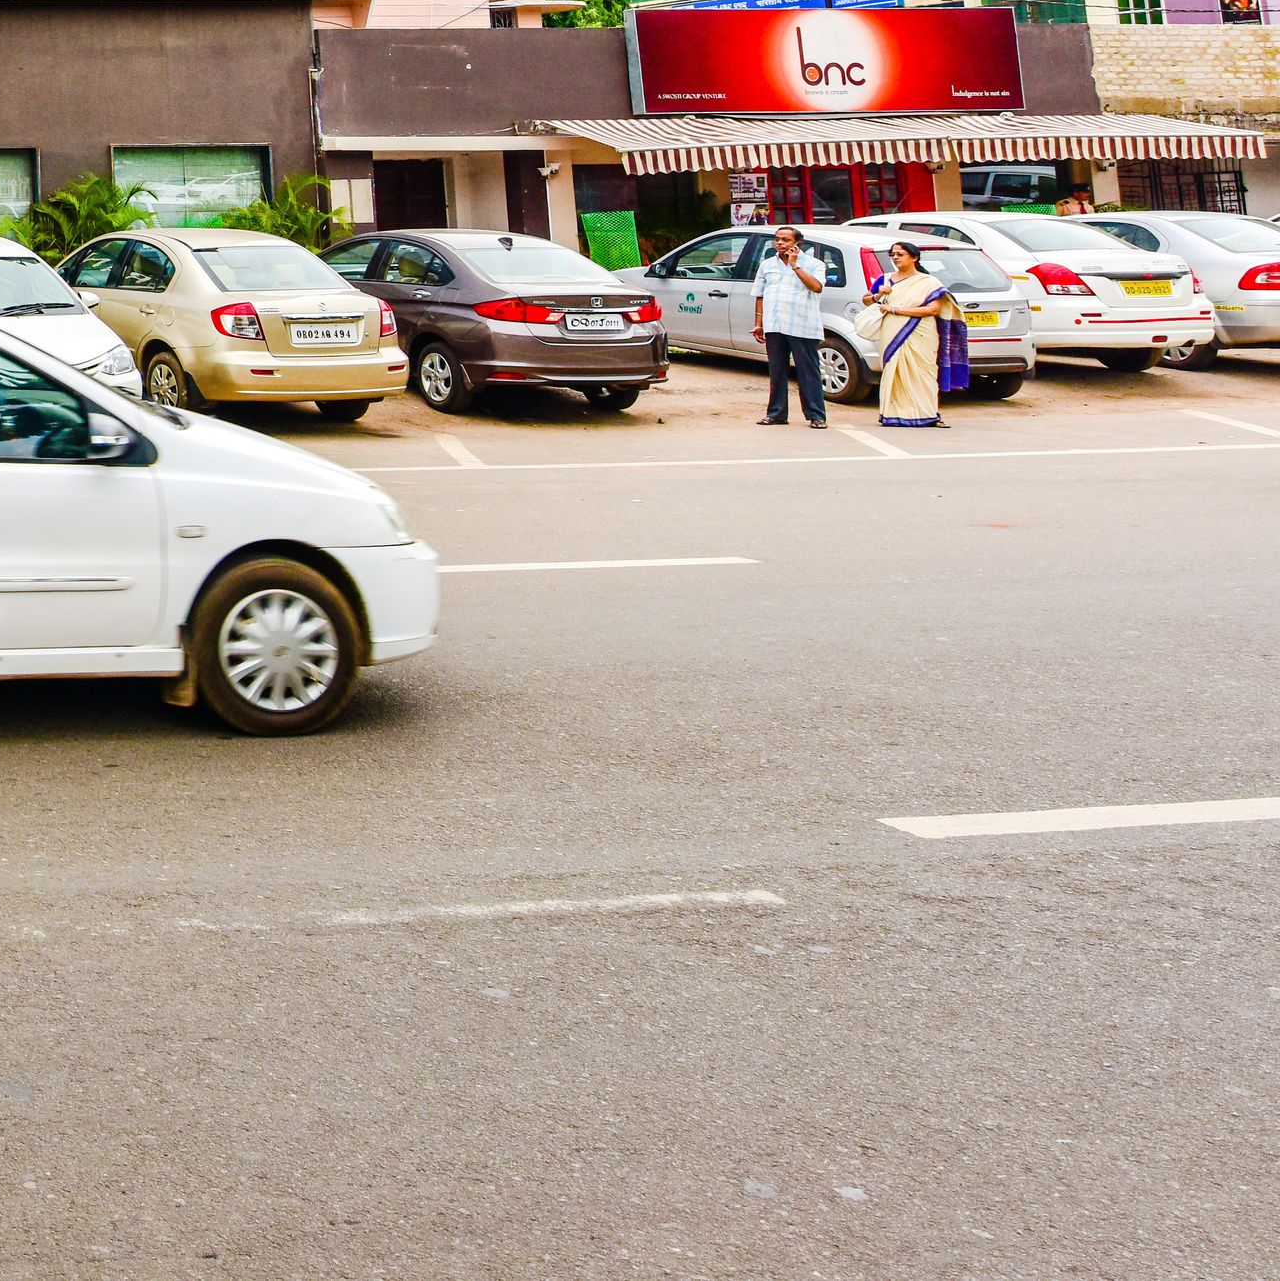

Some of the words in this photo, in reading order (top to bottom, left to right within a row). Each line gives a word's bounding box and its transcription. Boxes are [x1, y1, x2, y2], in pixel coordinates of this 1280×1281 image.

[796, 26, 866, 86] bnc
[951, 85, 983, 98] Indulgence
[678, 303, 703, 314] Swosti
